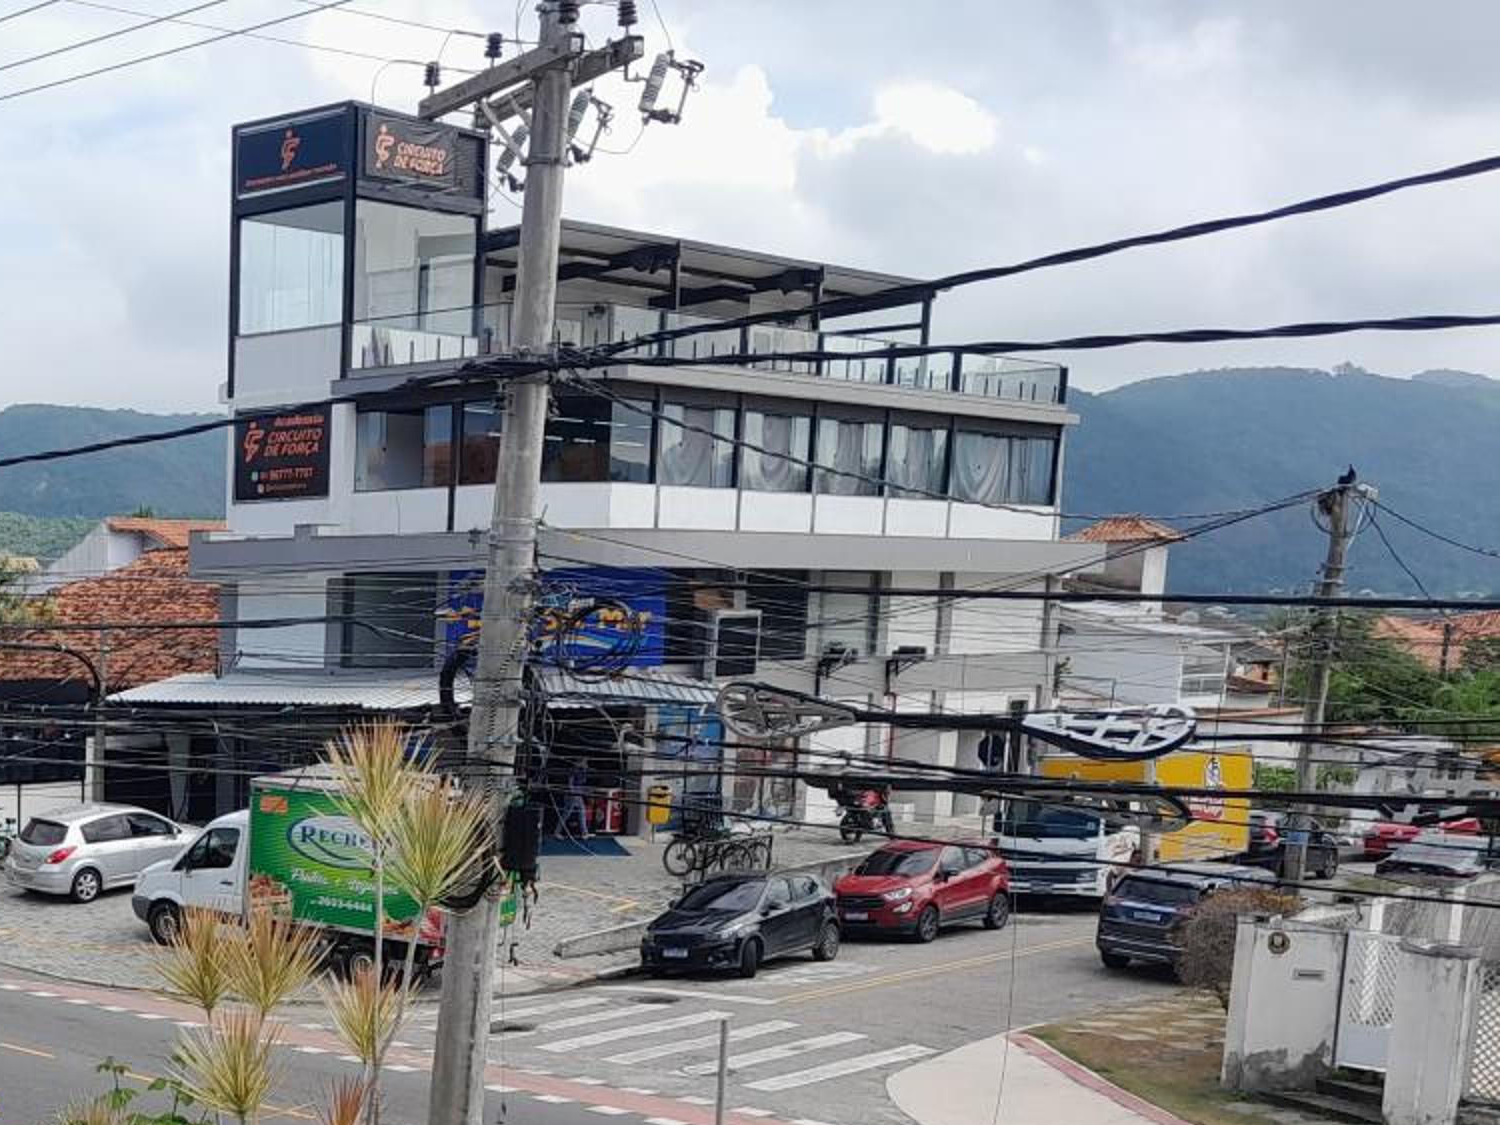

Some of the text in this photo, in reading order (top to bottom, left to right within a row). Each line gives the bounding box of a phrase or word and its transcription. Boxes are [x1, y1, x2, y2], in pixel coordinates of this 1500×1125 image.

[397, 142, 447, 163] CIRCUITO
[393, 155, 408, 169] DE
[267, 428, 324, 444] CIRCUITO
[263, 441, 319, 457] DE FORÇA
